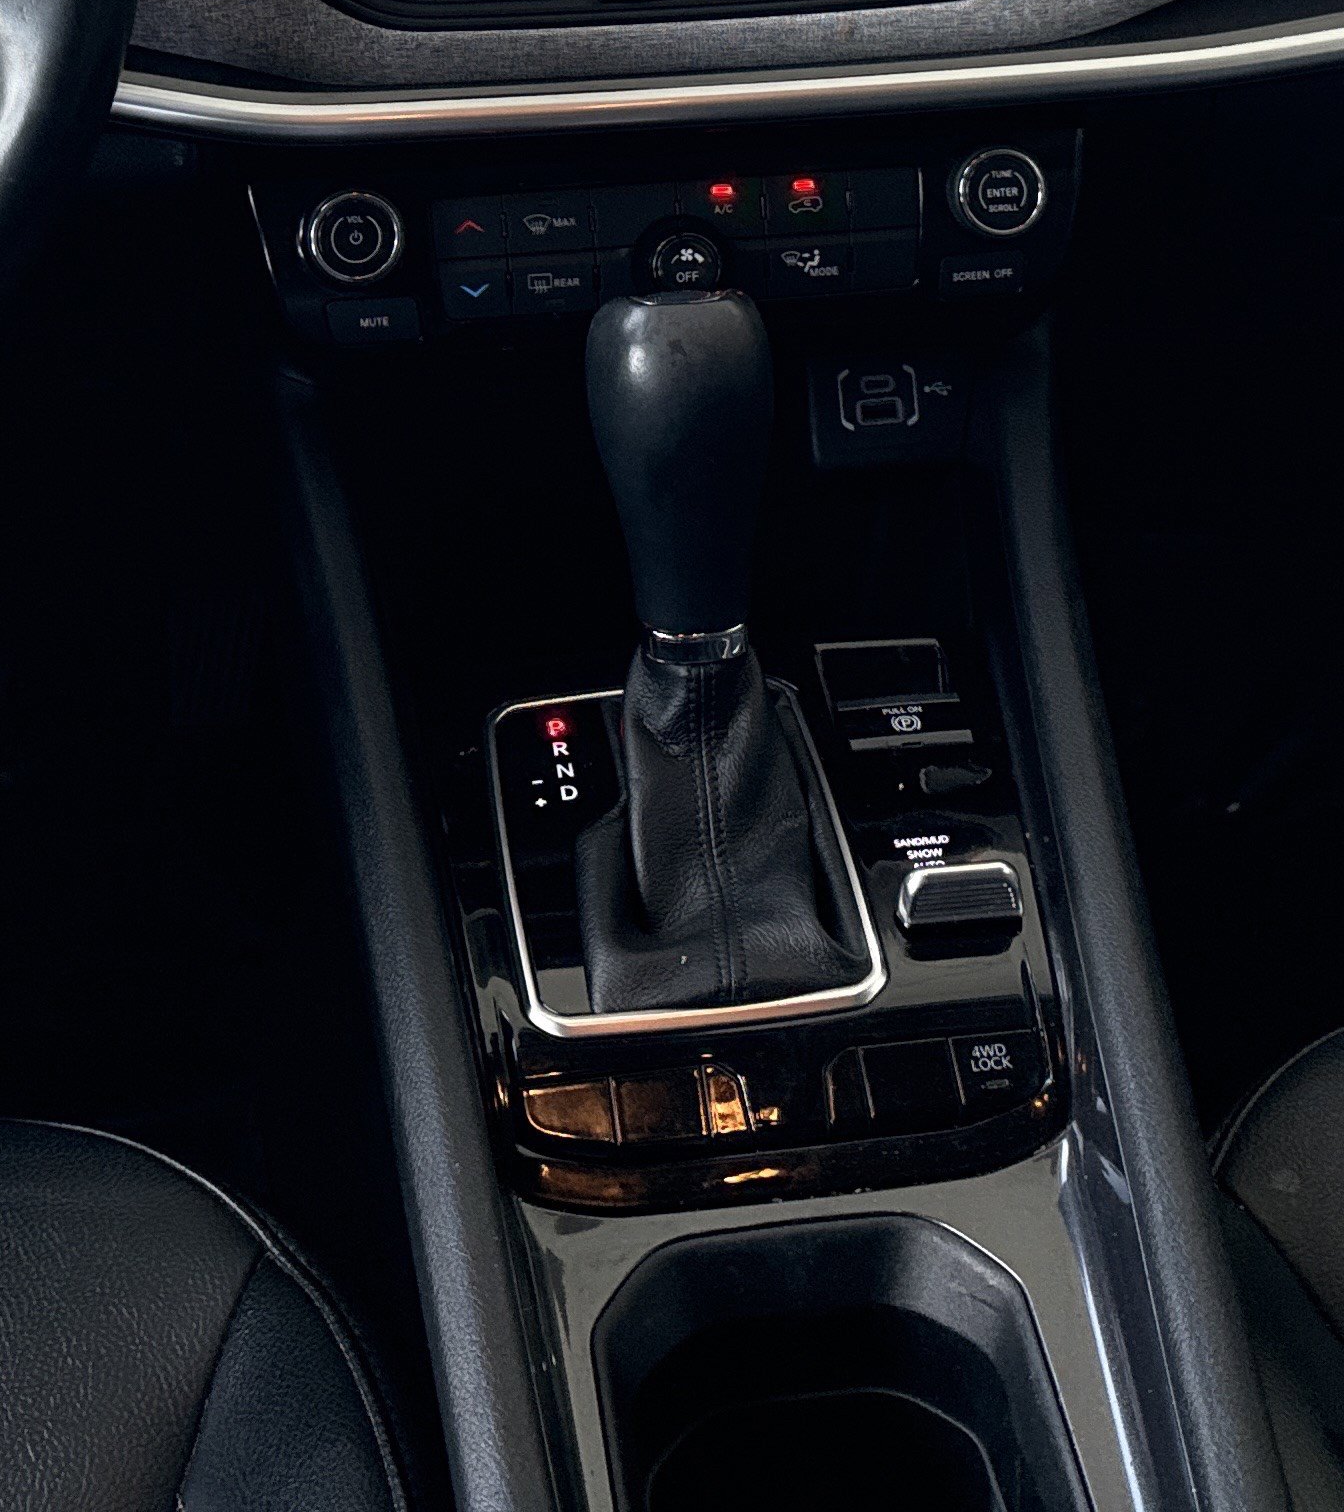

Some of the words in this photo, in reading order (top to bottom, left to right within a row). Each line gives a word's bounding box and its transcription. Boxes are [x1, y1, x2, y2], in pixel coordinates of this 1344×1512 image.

[991, 170, 1014, 179] TUNE
[987, 187, 1018, 198] ENTER
[714, 203, 734, 215] A/C
[988, 202, 1019, 212] SCROLL
[346, 215, 363, 224] VOL
[676, 271, 700, 283] OFF
[810, 266, 839, 277] MODE
[952, 271, 990, 282] SCREEN
[994, 268, 1014, 279] OFF
[554, 276, 581, 288] REAR
[360, 316, 390, 328] MUTE
[546, 719, 565, 737] P
[552, 741, 569, 756] R
[556, 763, 575, 778] N
[560, 785, 578, 801] D
[906, 848, 943, 860] SNOW
[972, 1043, 1006, 1057] 4WD
[971, 1056, 1013, 1072] LOCK
